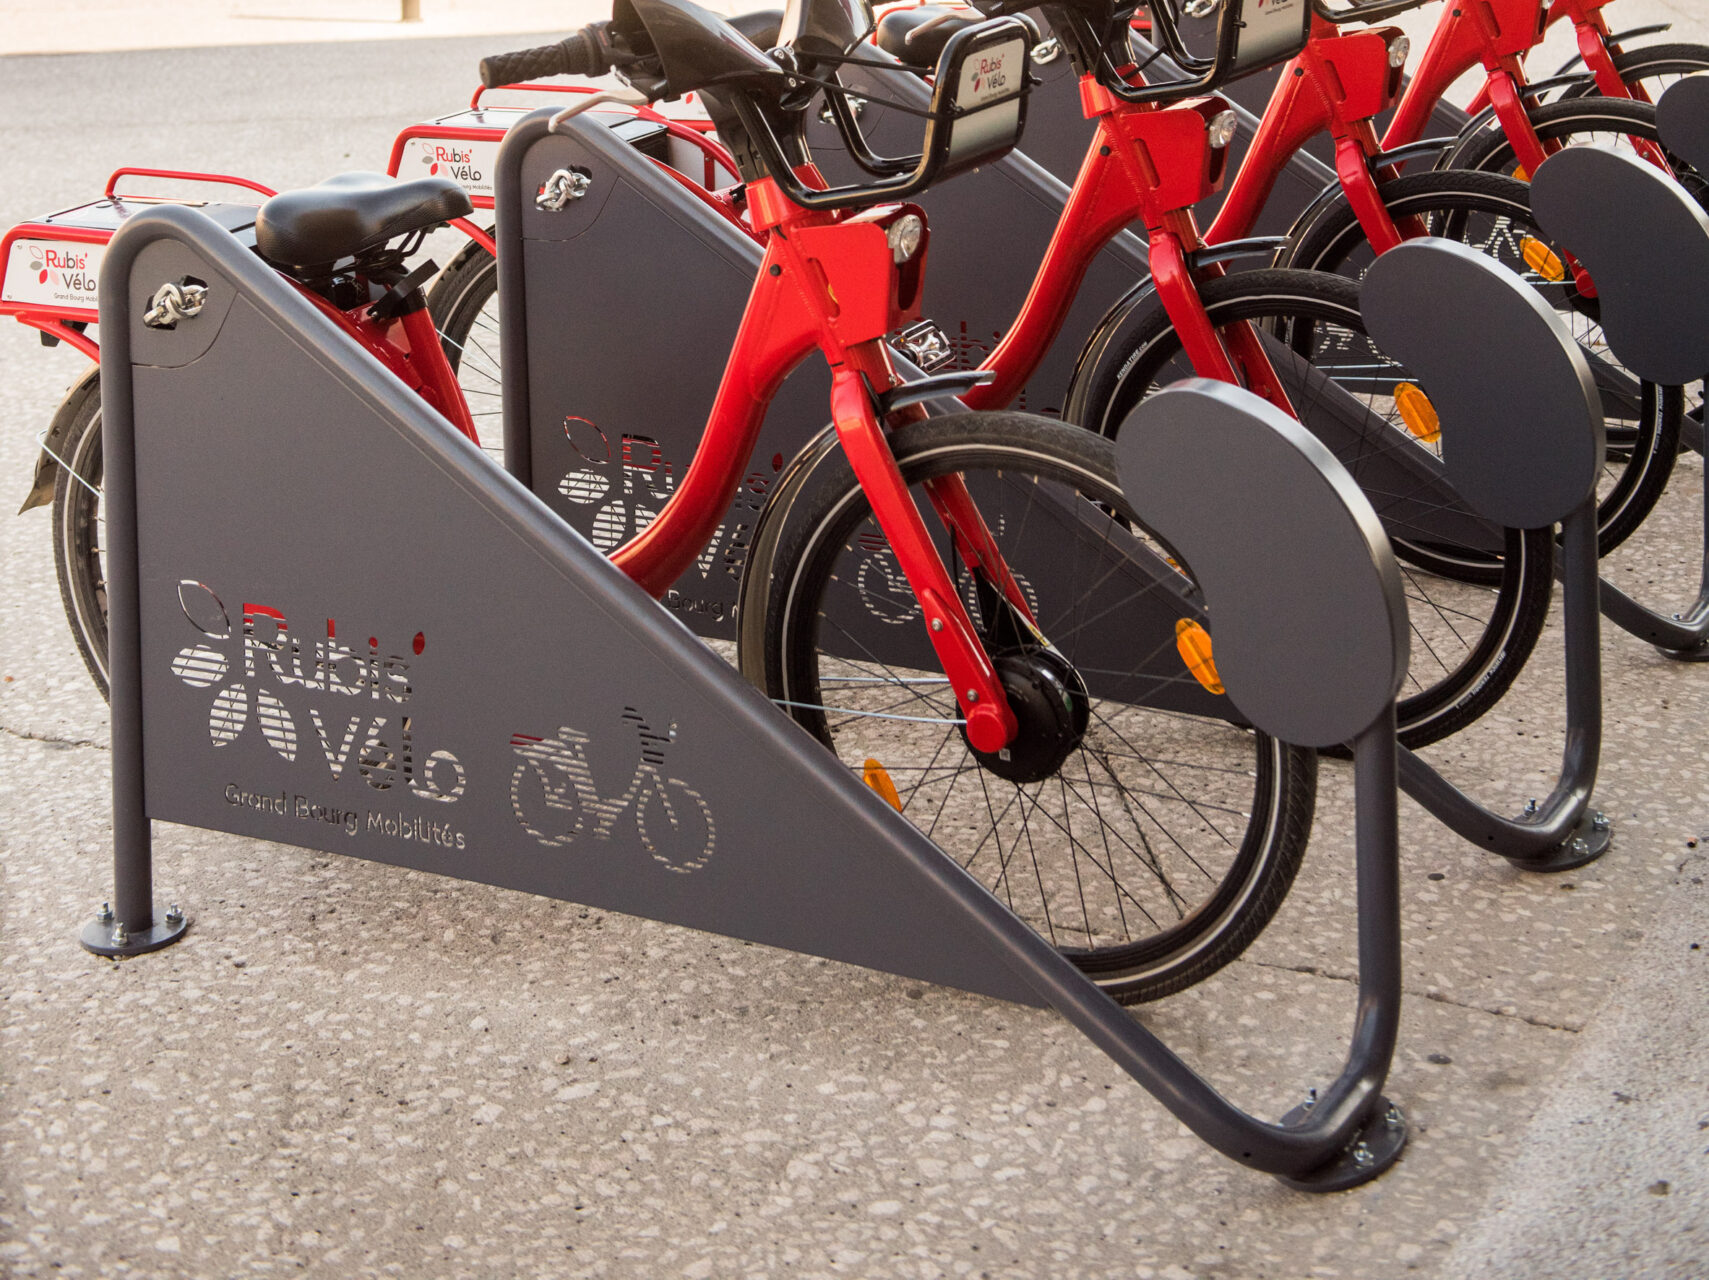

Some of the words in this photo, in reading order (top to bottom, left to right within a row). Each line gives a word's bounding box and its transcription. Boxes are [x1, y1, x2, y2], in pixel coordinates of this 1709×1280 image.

[987, 71, 1006, 90] Vélo
[435, 146, 473, 163] Rubis'
[450, 164, 482, 181] Vélo
[45, 249, 88, 270] Rubis'
[62, 271, 97, 292] Vélo
[667, 589, 724, 622] Bourg
[242, 602, 426, 703] Rubis'
[309, 707, 466, 803] Vélo
[224, 782, 288, 816] Grand
[293, 793, 358, 836] Bourg
[366, 809, 466, 850] Mobilités
